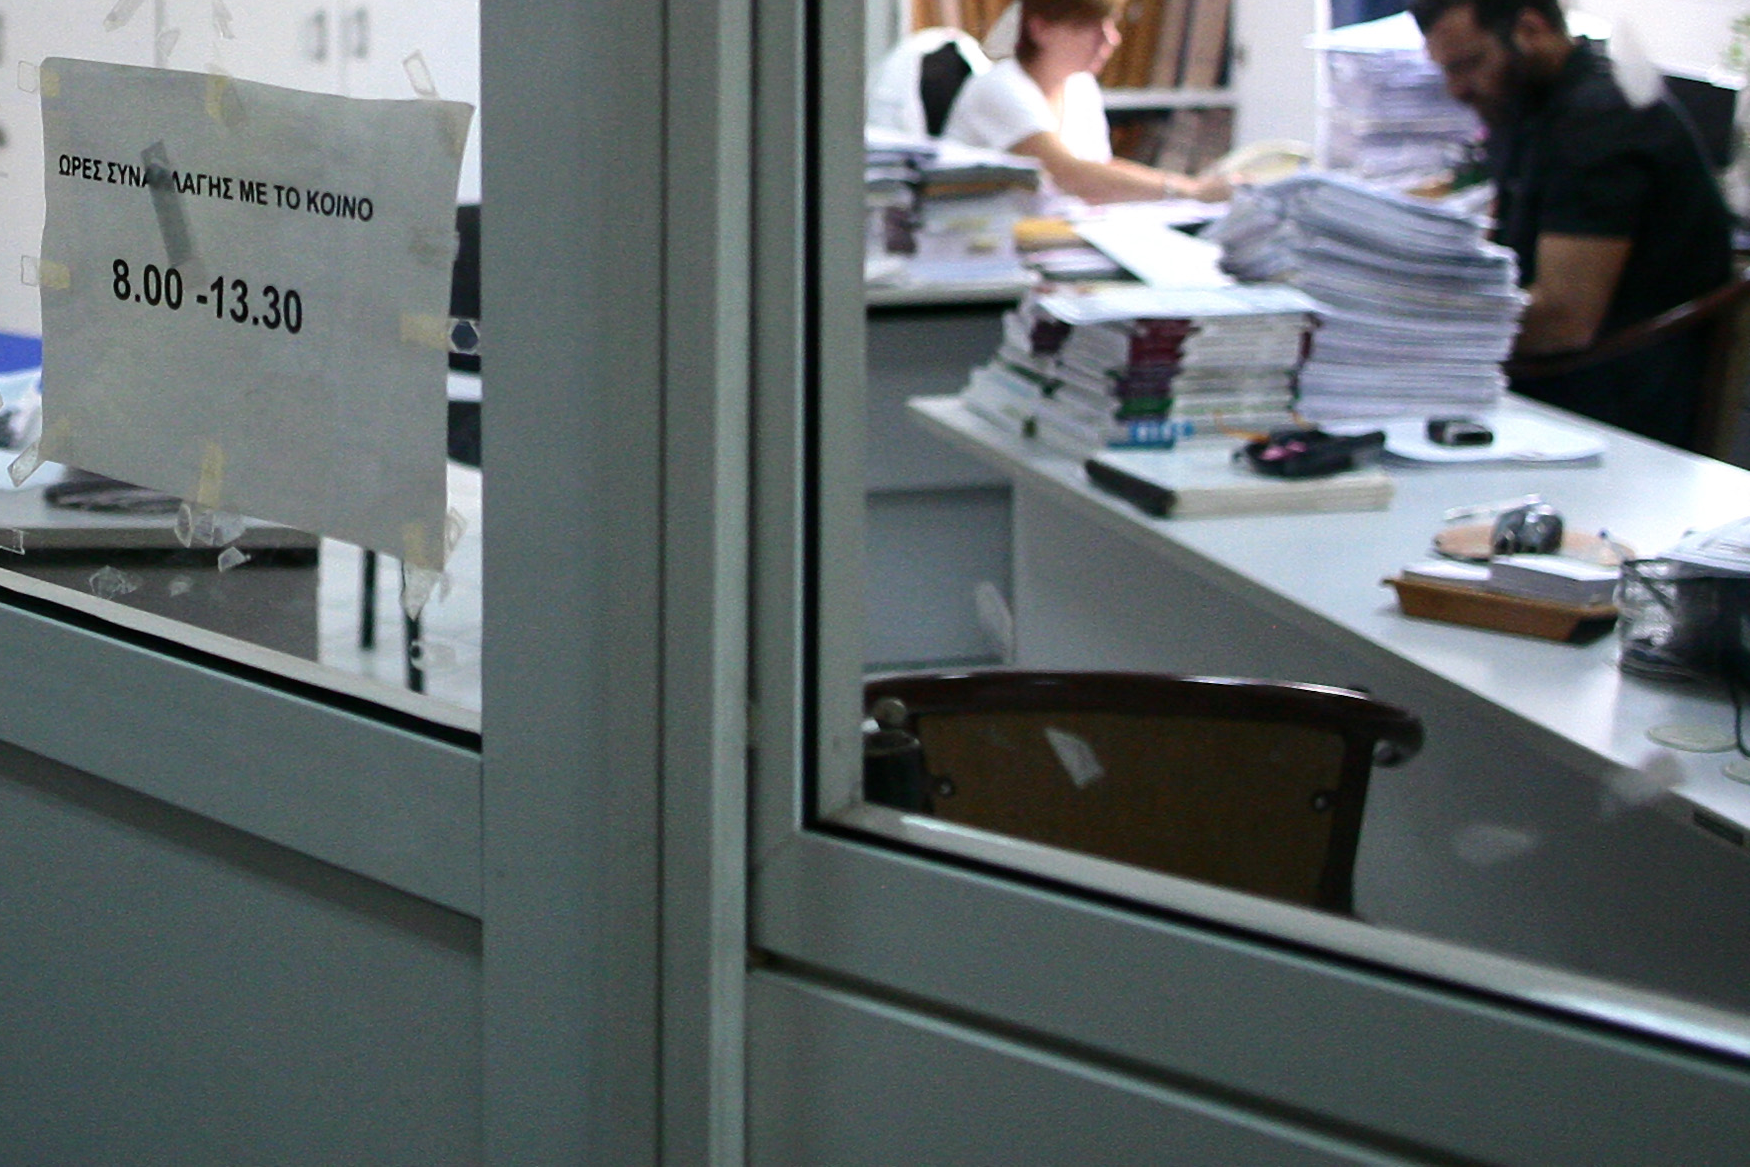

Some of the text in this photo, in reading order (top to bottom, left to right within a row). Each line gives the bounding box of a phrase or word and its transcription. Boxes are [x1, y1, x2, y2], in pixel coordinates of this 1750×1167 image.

[59, 154, 374, 222] ΩΡΕΣ ΣΥΝΑΛΑΓΗΣ ΜΕ ΤΟ ΚΟΙΝΟ
[112, 258, 183, 311] 8.00
